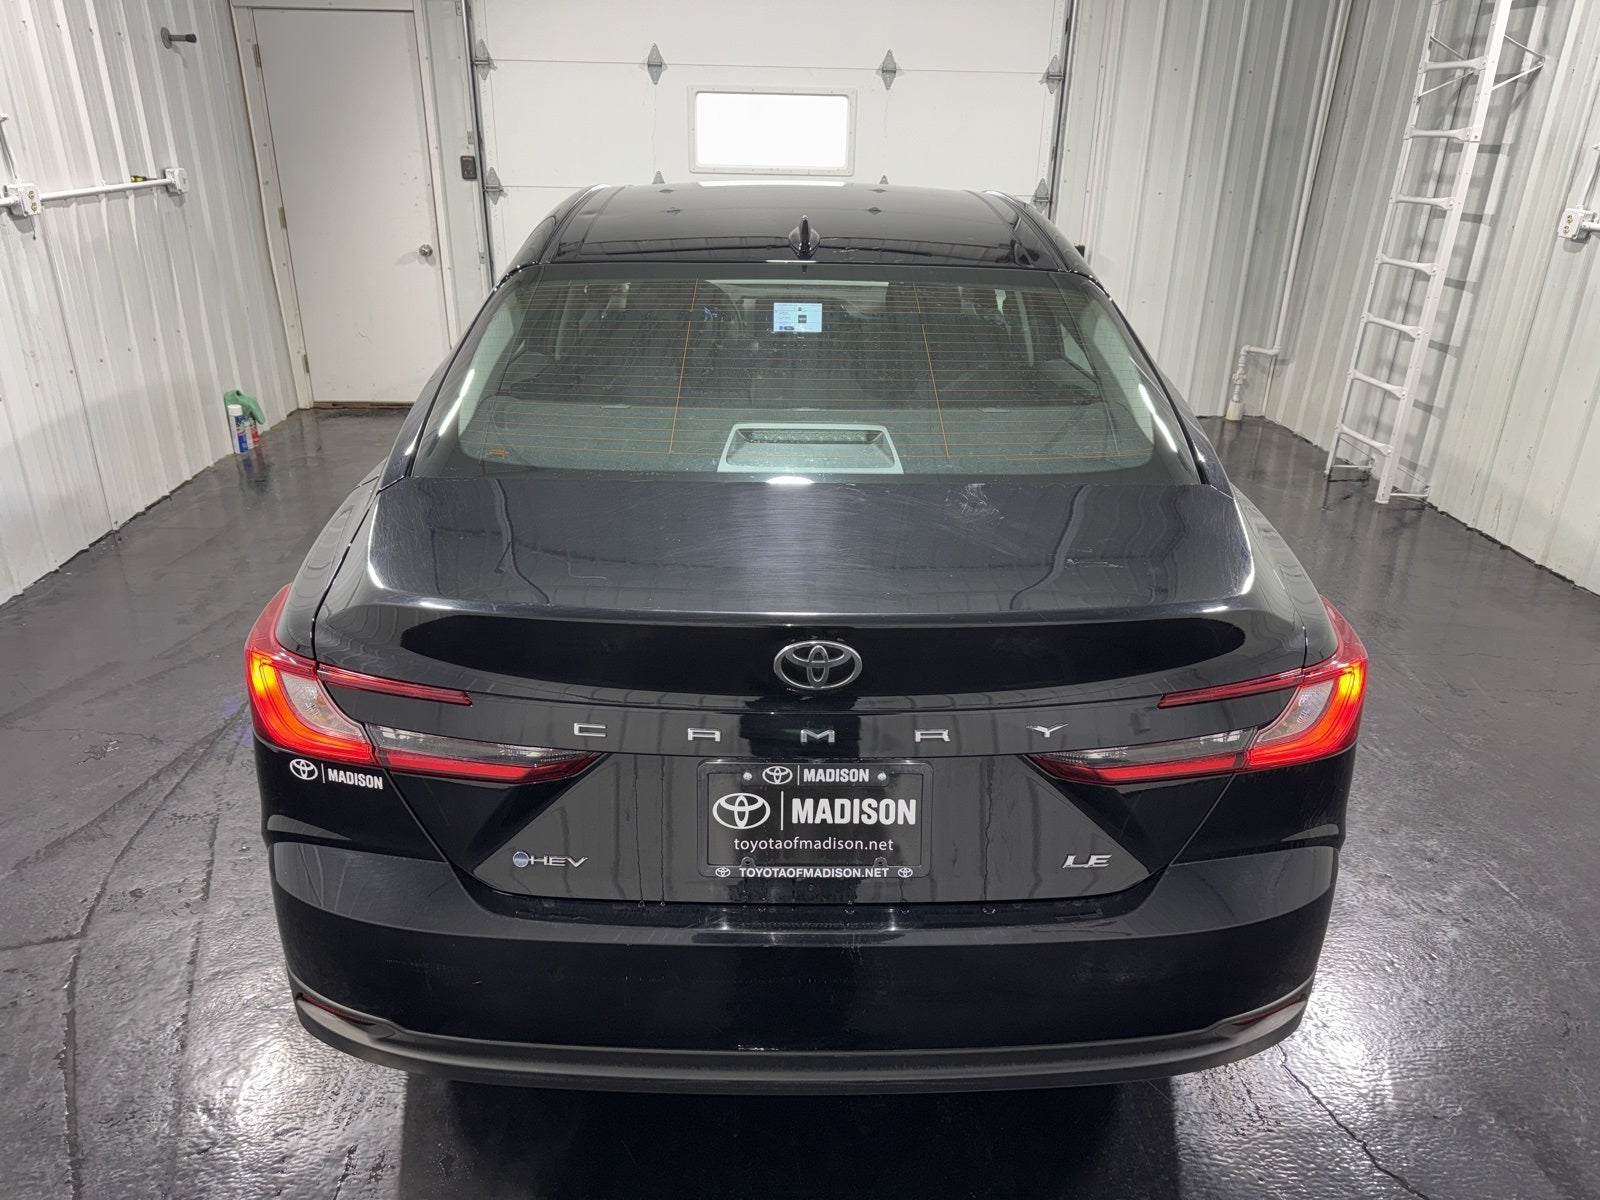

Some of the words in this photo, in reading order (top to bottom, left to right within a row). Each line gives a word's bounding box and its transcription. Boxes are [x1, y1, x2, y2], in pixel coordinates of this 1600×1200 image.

[327, 768, 383, 790] MADISON
[804, 768, 869, 782] MADISON
[792, 798, 917, 825] MADISON
[734, 837, 894, 853] toyotaofmadison.net
[530, 855, 588, 868] HEV
[1062, 854, 1113, 868] LE
[739, 867, 889, 878] TOYOTAOFMADISON.NET
